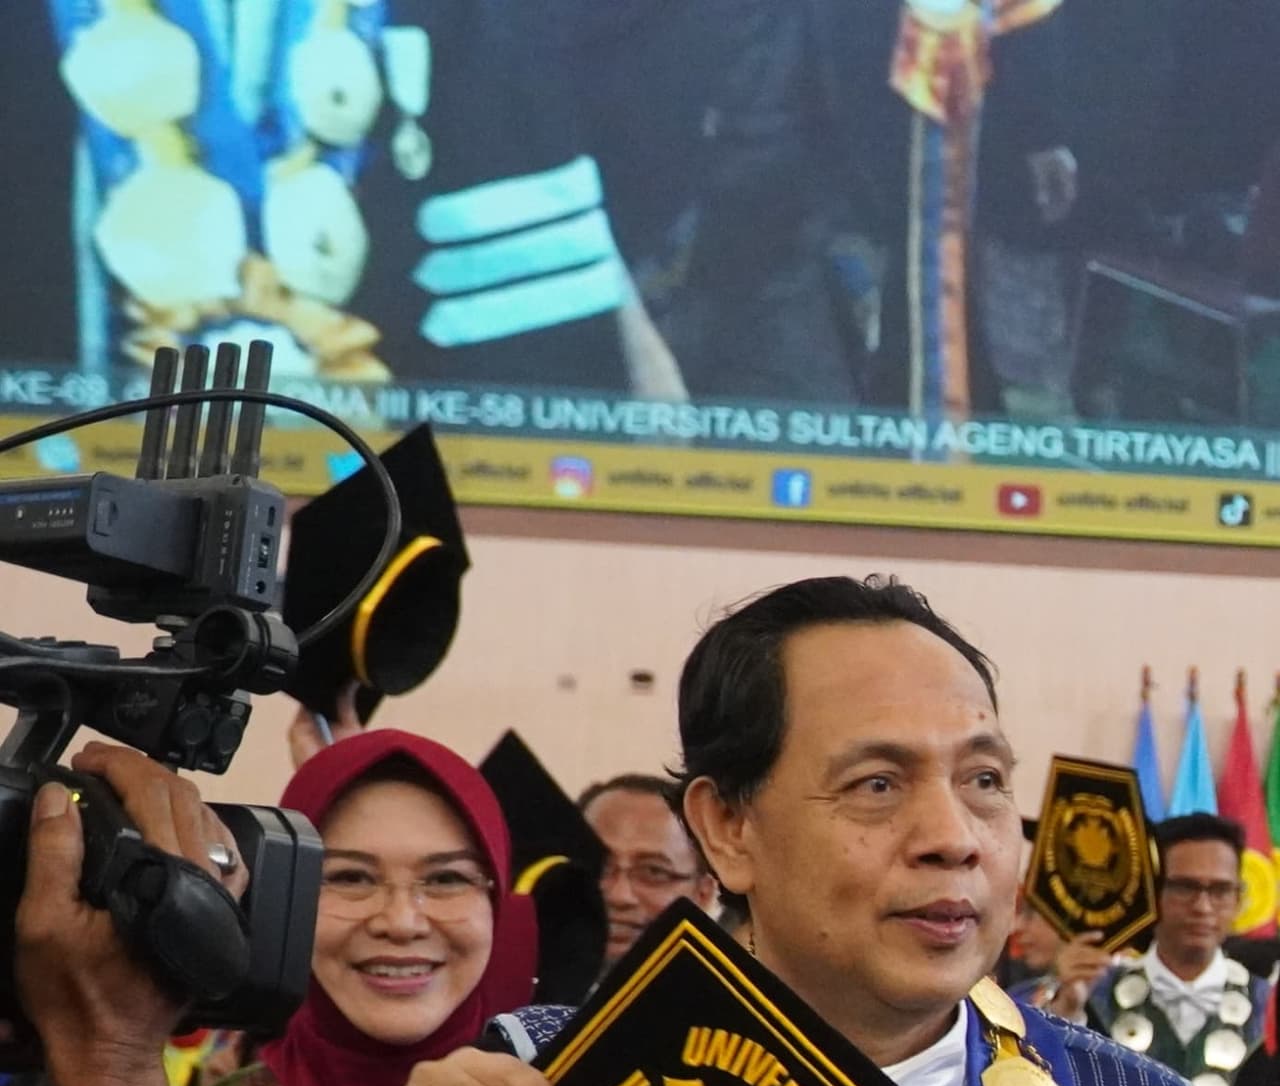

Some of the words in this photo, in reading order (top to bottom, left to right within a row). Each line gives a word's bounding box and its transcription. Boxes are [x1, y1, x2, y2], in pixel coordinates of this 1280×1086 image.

[532, 396, 780, 443] UNIVERSITAS
[788, 410, 927, 450] SULTAN
[932, 420, 1064, 459] AGENG
[1072, 427, 1261, 471] TIRTAYASA
